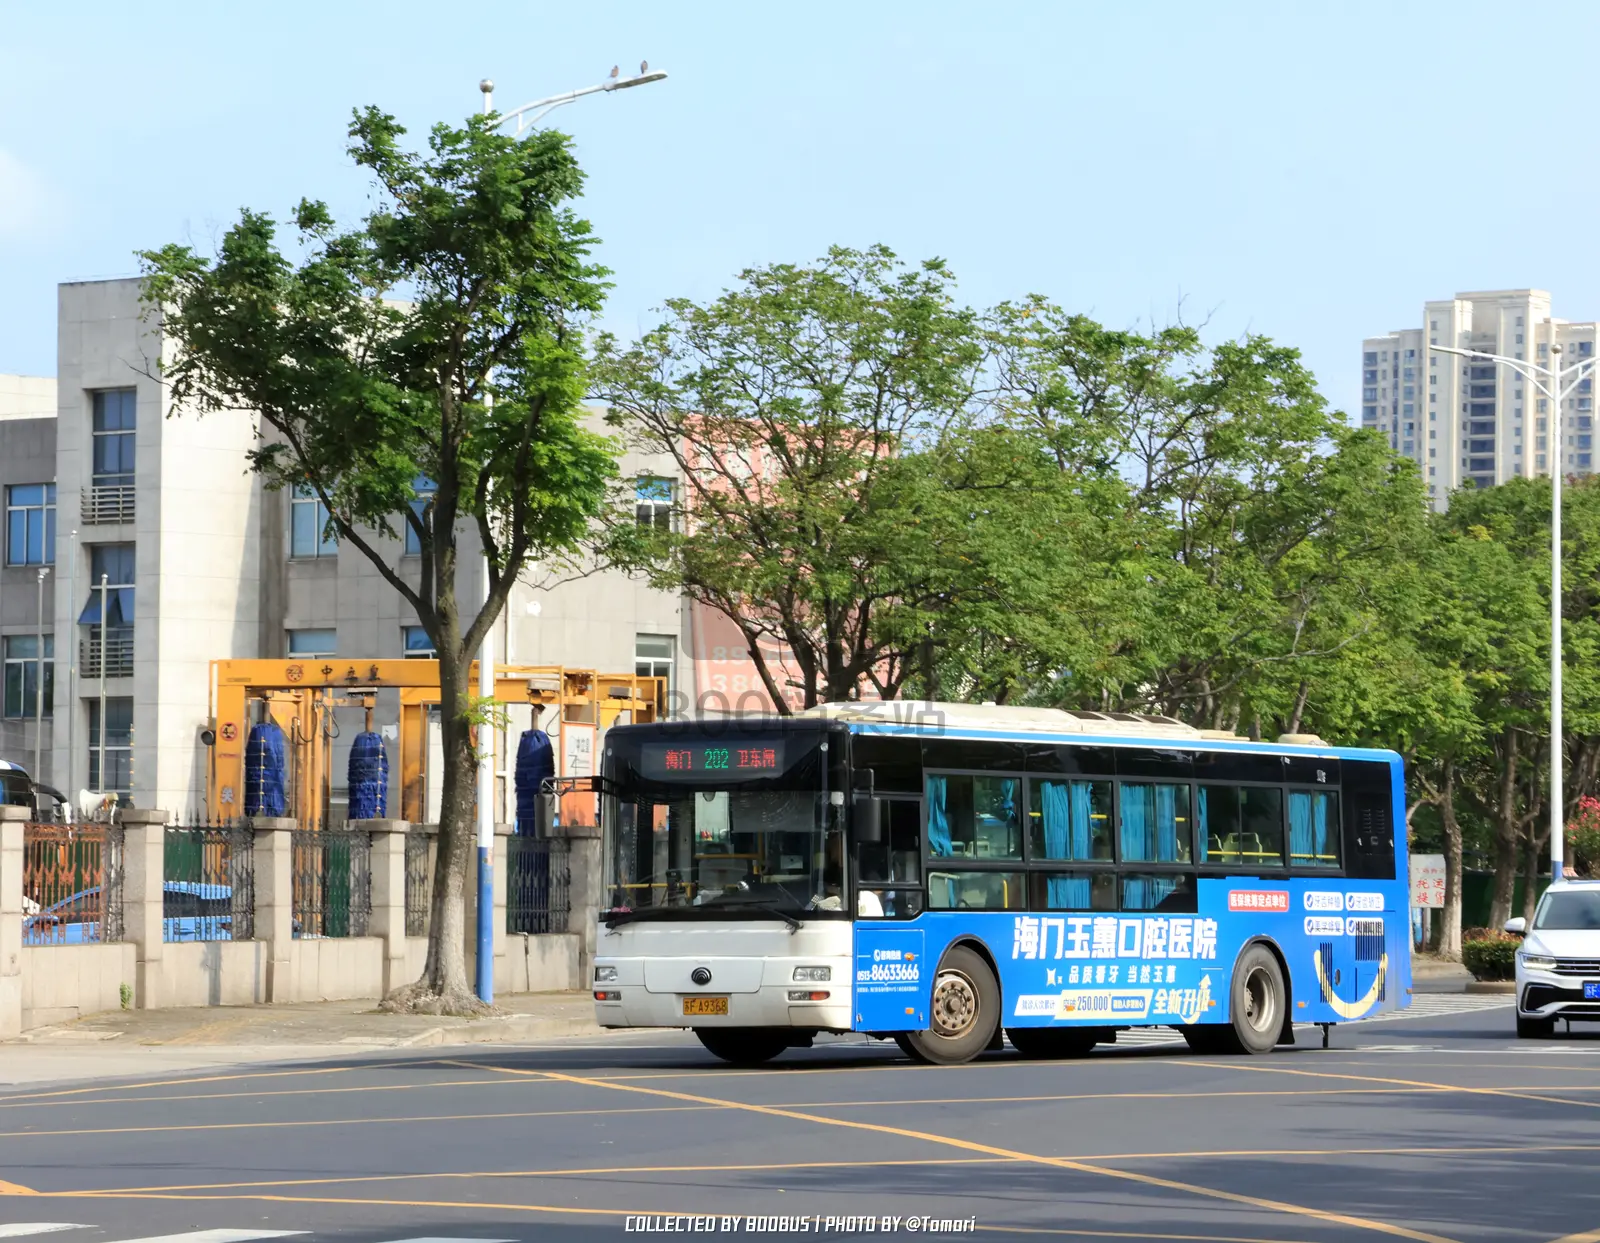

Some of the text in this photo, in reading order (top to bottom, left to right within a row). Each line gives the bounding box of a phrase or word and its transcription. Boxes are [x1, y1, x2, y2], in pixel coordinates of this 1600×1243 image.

[665, 748, 776, 770] 海门 202 卫东闸
[1011, 916, 1218, 960] 海门玉蕙口腔医院
[857, 963, 920, 981] 0513-86633666
[1068, 965, 1119, 984] 品质看牙
